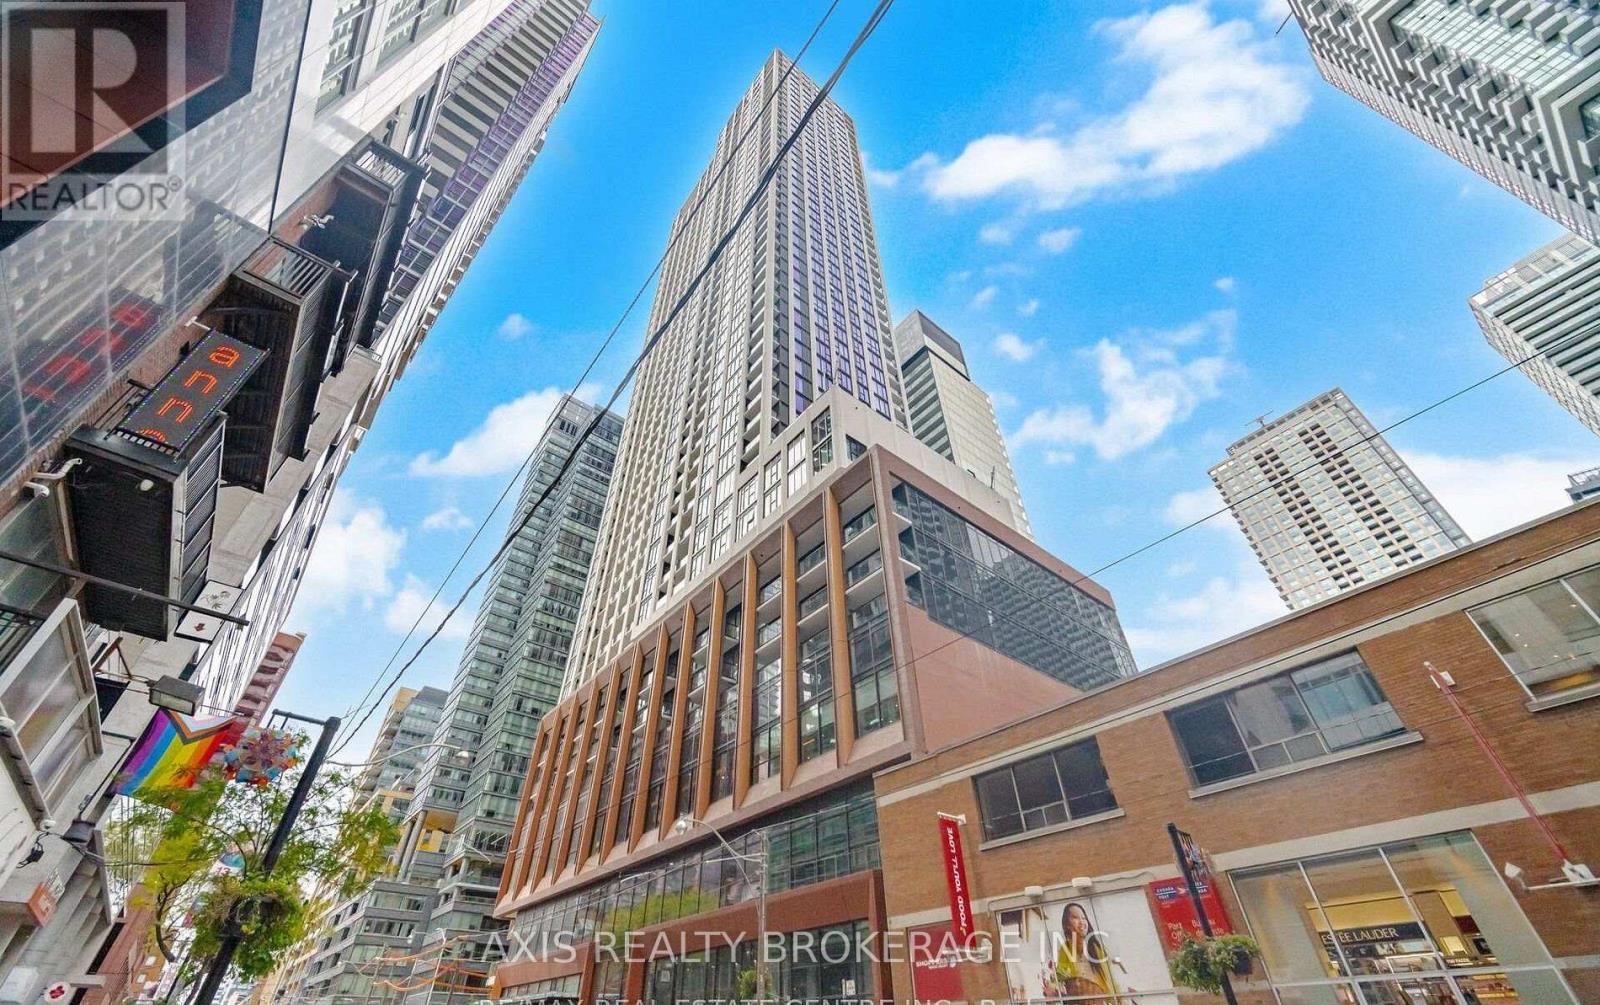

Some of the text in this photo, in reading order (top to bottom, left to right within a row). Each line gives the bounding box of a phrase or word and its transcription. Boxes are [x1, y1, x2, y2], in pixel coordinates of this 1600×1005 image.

[946, 827, 956, 853] LOVE
[957, 895, 968, 928] FOOD
[1353, 927, 1400, 942] LAUDER
